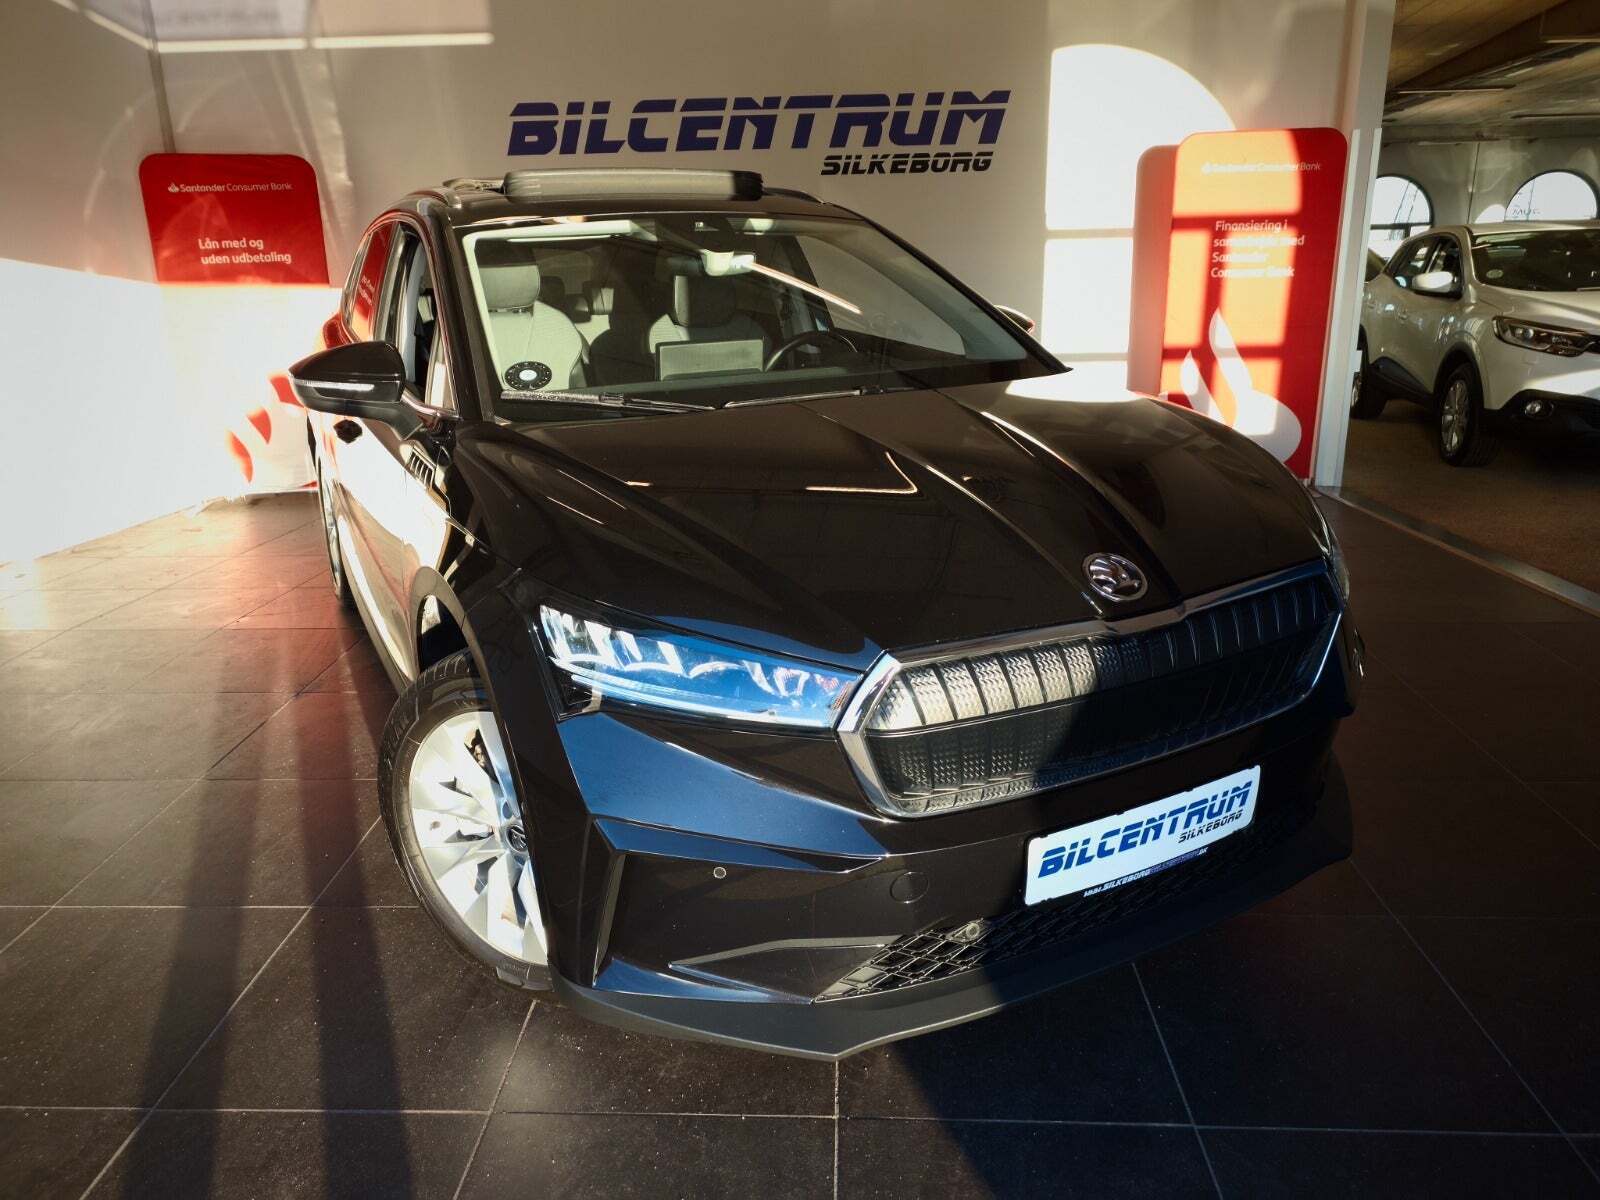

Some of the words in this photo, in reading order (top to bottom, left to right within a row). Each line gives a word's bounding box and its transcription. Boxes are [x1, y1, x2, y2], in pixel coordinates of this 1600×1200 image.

[507, 90, 1011, 156] BILCENTRUM
[820, 151, 994, 176] SILKEBORG
[180, 183, 225, 192] Santander
[226, 183, 269, 192] Consumer
[270, 182, 293, 191] Bank
[1215, 219, 1282, 233] Finansiering
[1283, 219, 1288, 230] i
[198, 237, 219, 250] Lån
[222, 237, 247, 249] med
[249, 240, 264, 250] og
[201, 253, 230, 265] uden
[232, 252, 292, 265] udbetaling
[1037, 780, 1253, 879] BILCENTRUM
[1178, 809, 1243, 844] SILKEBORG
